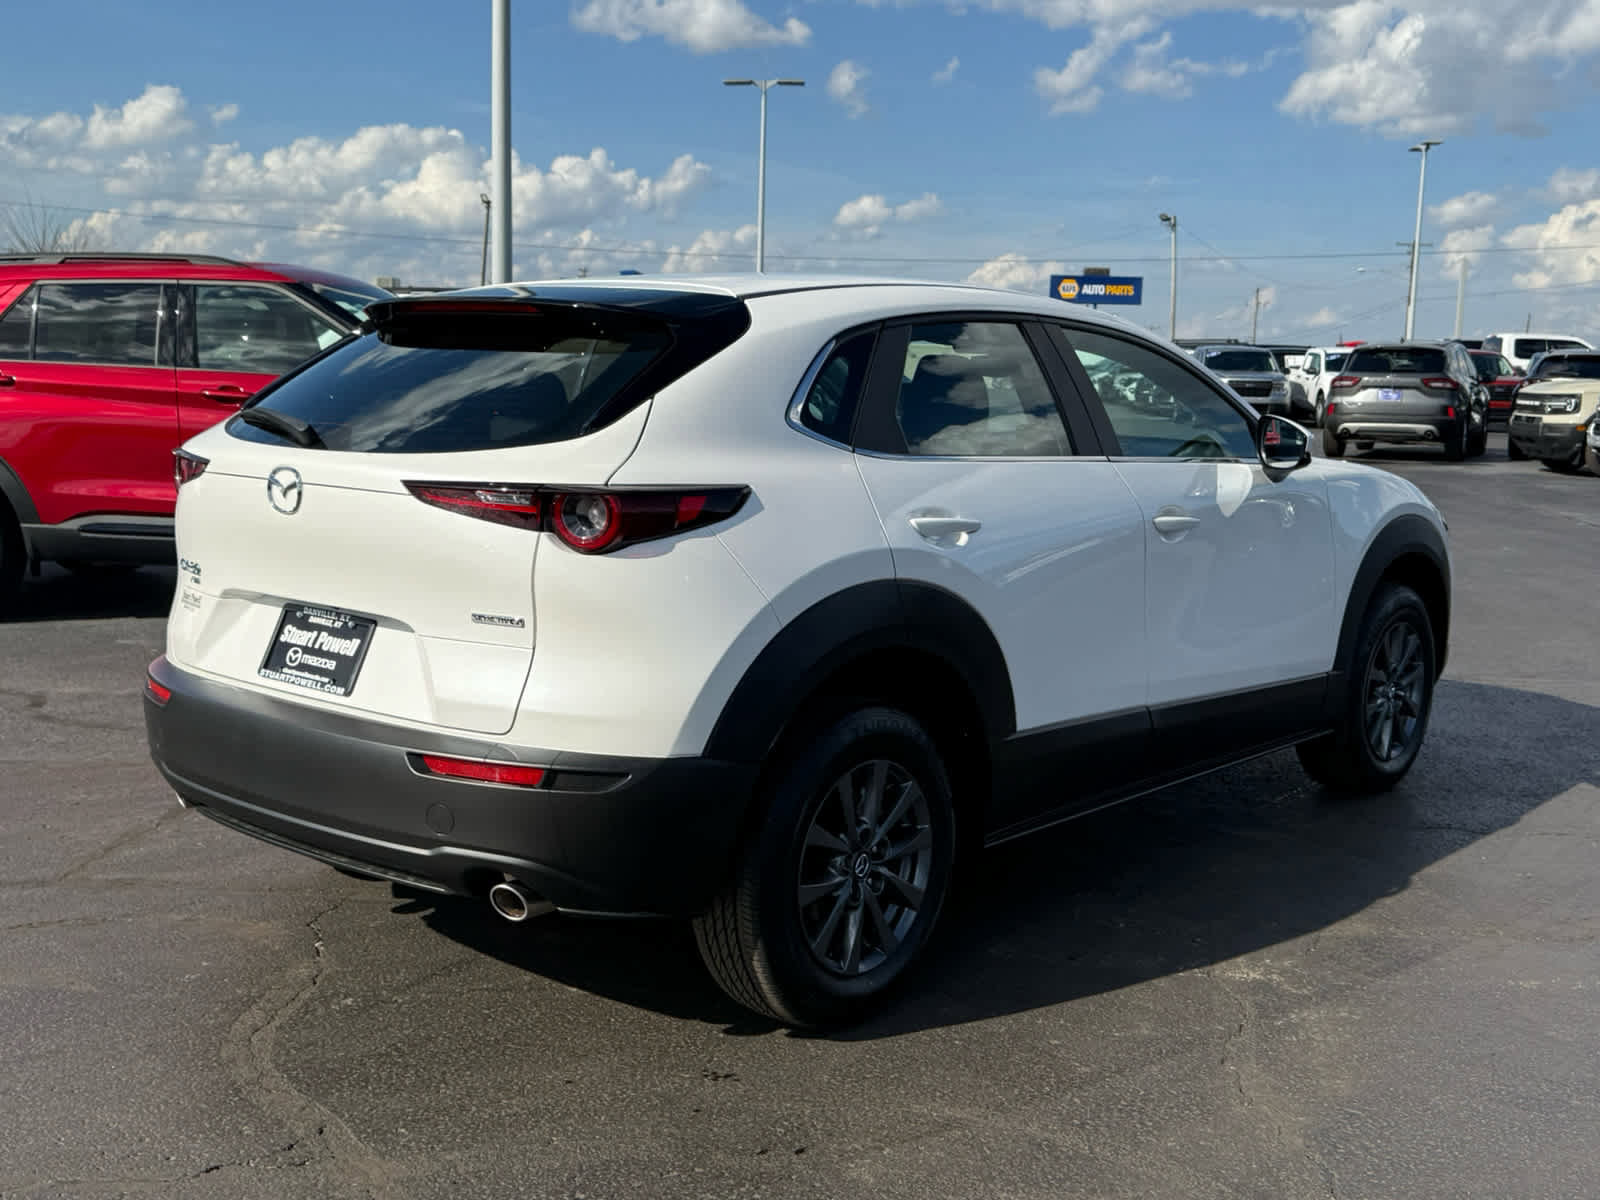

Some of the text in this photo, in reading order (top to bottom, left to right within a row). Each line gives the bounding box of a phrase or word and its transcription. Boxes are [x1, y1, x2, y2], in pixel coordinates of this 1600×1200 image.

[1081, 284, 1105, 295] AUTO
[1105, 285, 1134, 296] PARTS
[280, 623, 361, 657] Stuart Powell
[301, 654, 337, 671] mazda
[260, 668, 345, 695] STUARTPOWELL.COM
